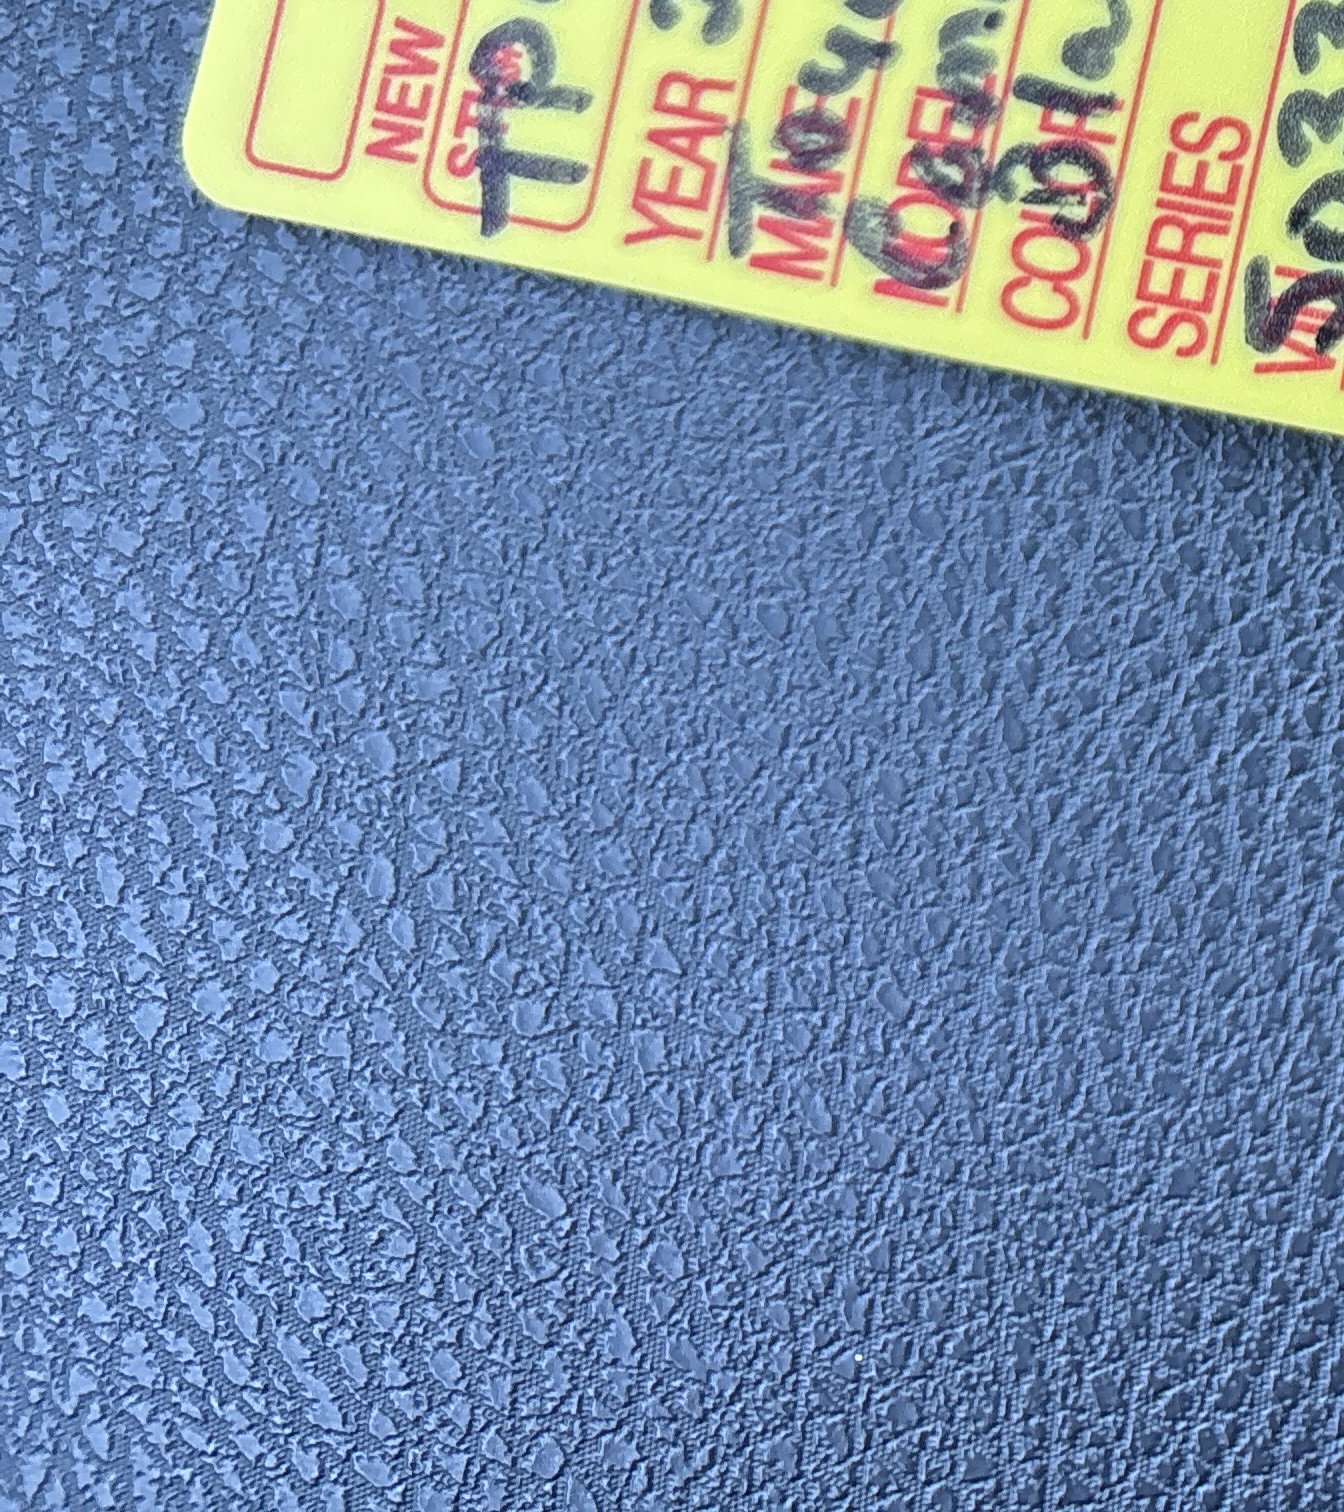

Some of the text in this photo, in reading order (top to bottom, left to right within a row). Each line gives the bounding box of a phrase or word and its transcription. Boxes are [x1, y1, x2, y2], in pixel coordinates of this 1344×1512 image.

[364, 17, 446, 165] NEW
[623, 69, 737, 246] YEAR
[1126, 110, 1252, 358] SERIES
